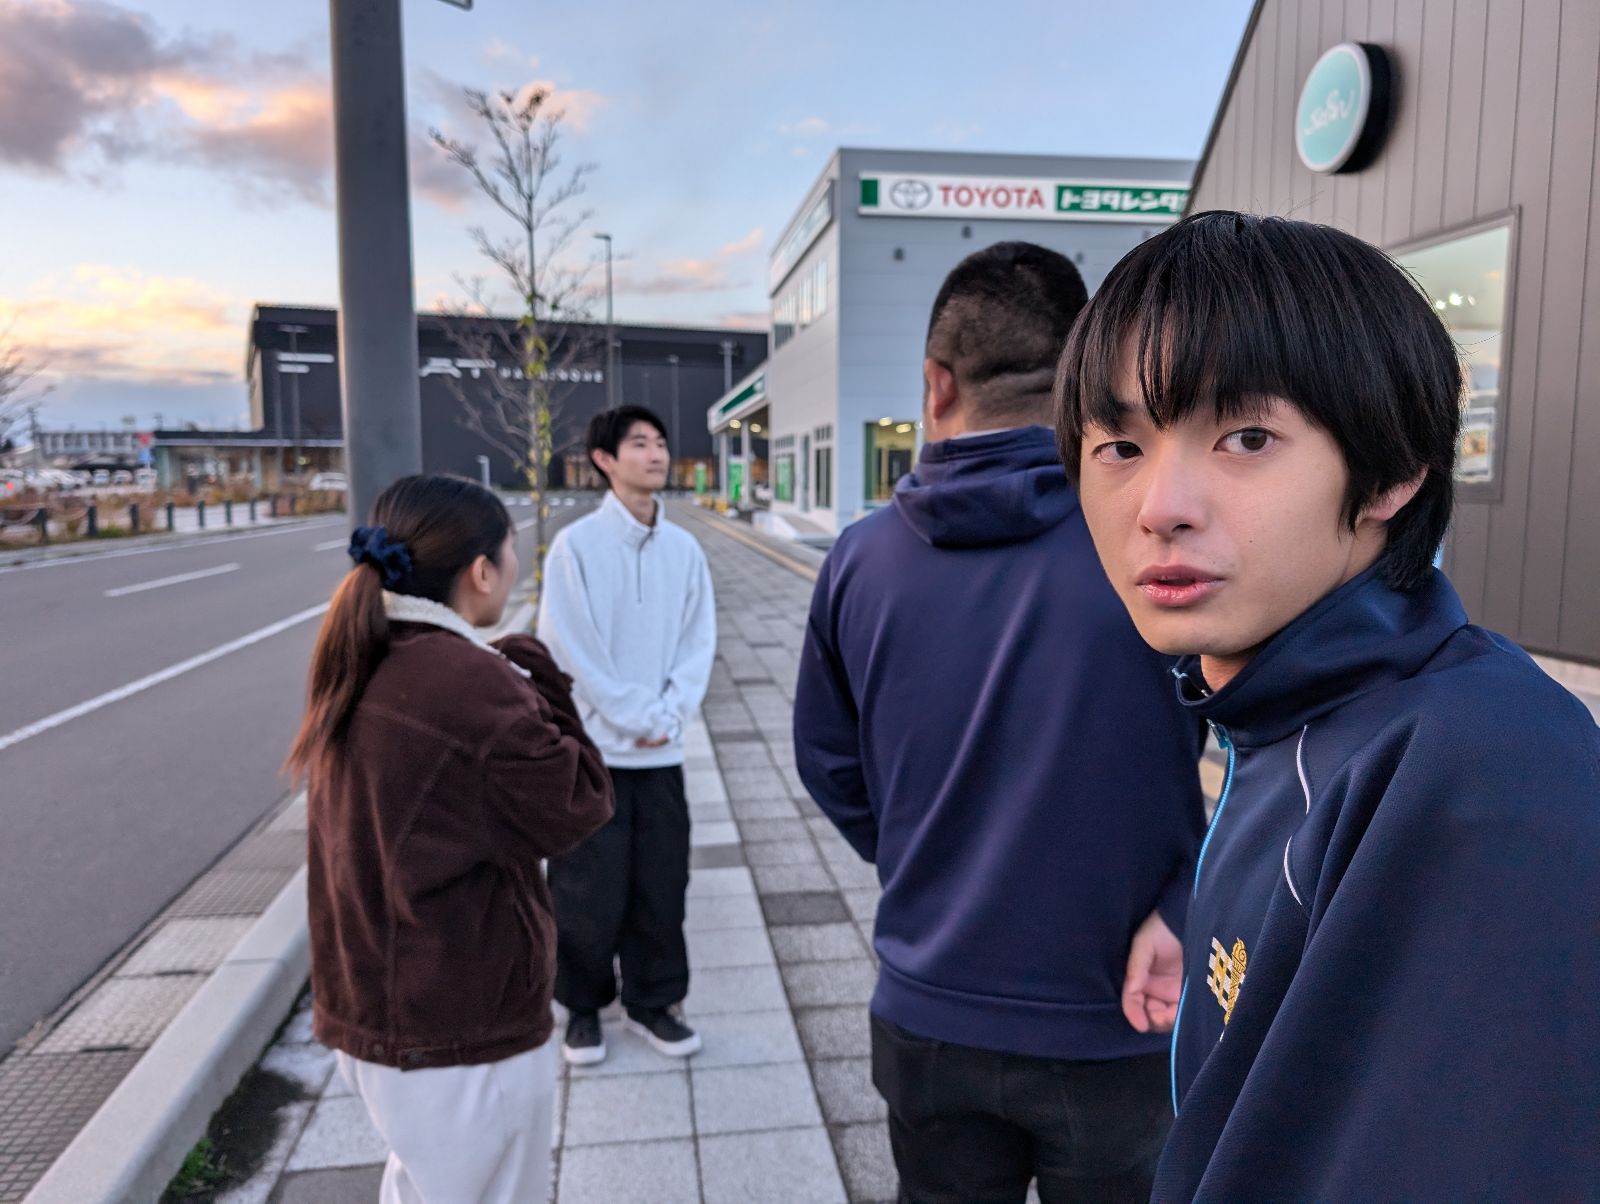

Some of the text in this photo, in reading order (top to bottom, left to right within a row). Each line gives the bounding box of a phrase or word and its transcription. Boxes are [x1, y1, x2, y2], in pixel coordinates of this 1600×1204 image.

[938, 185, 1046, 210] TOYOTA
[1060, 188, 1188, 212] トヨタレンタ
